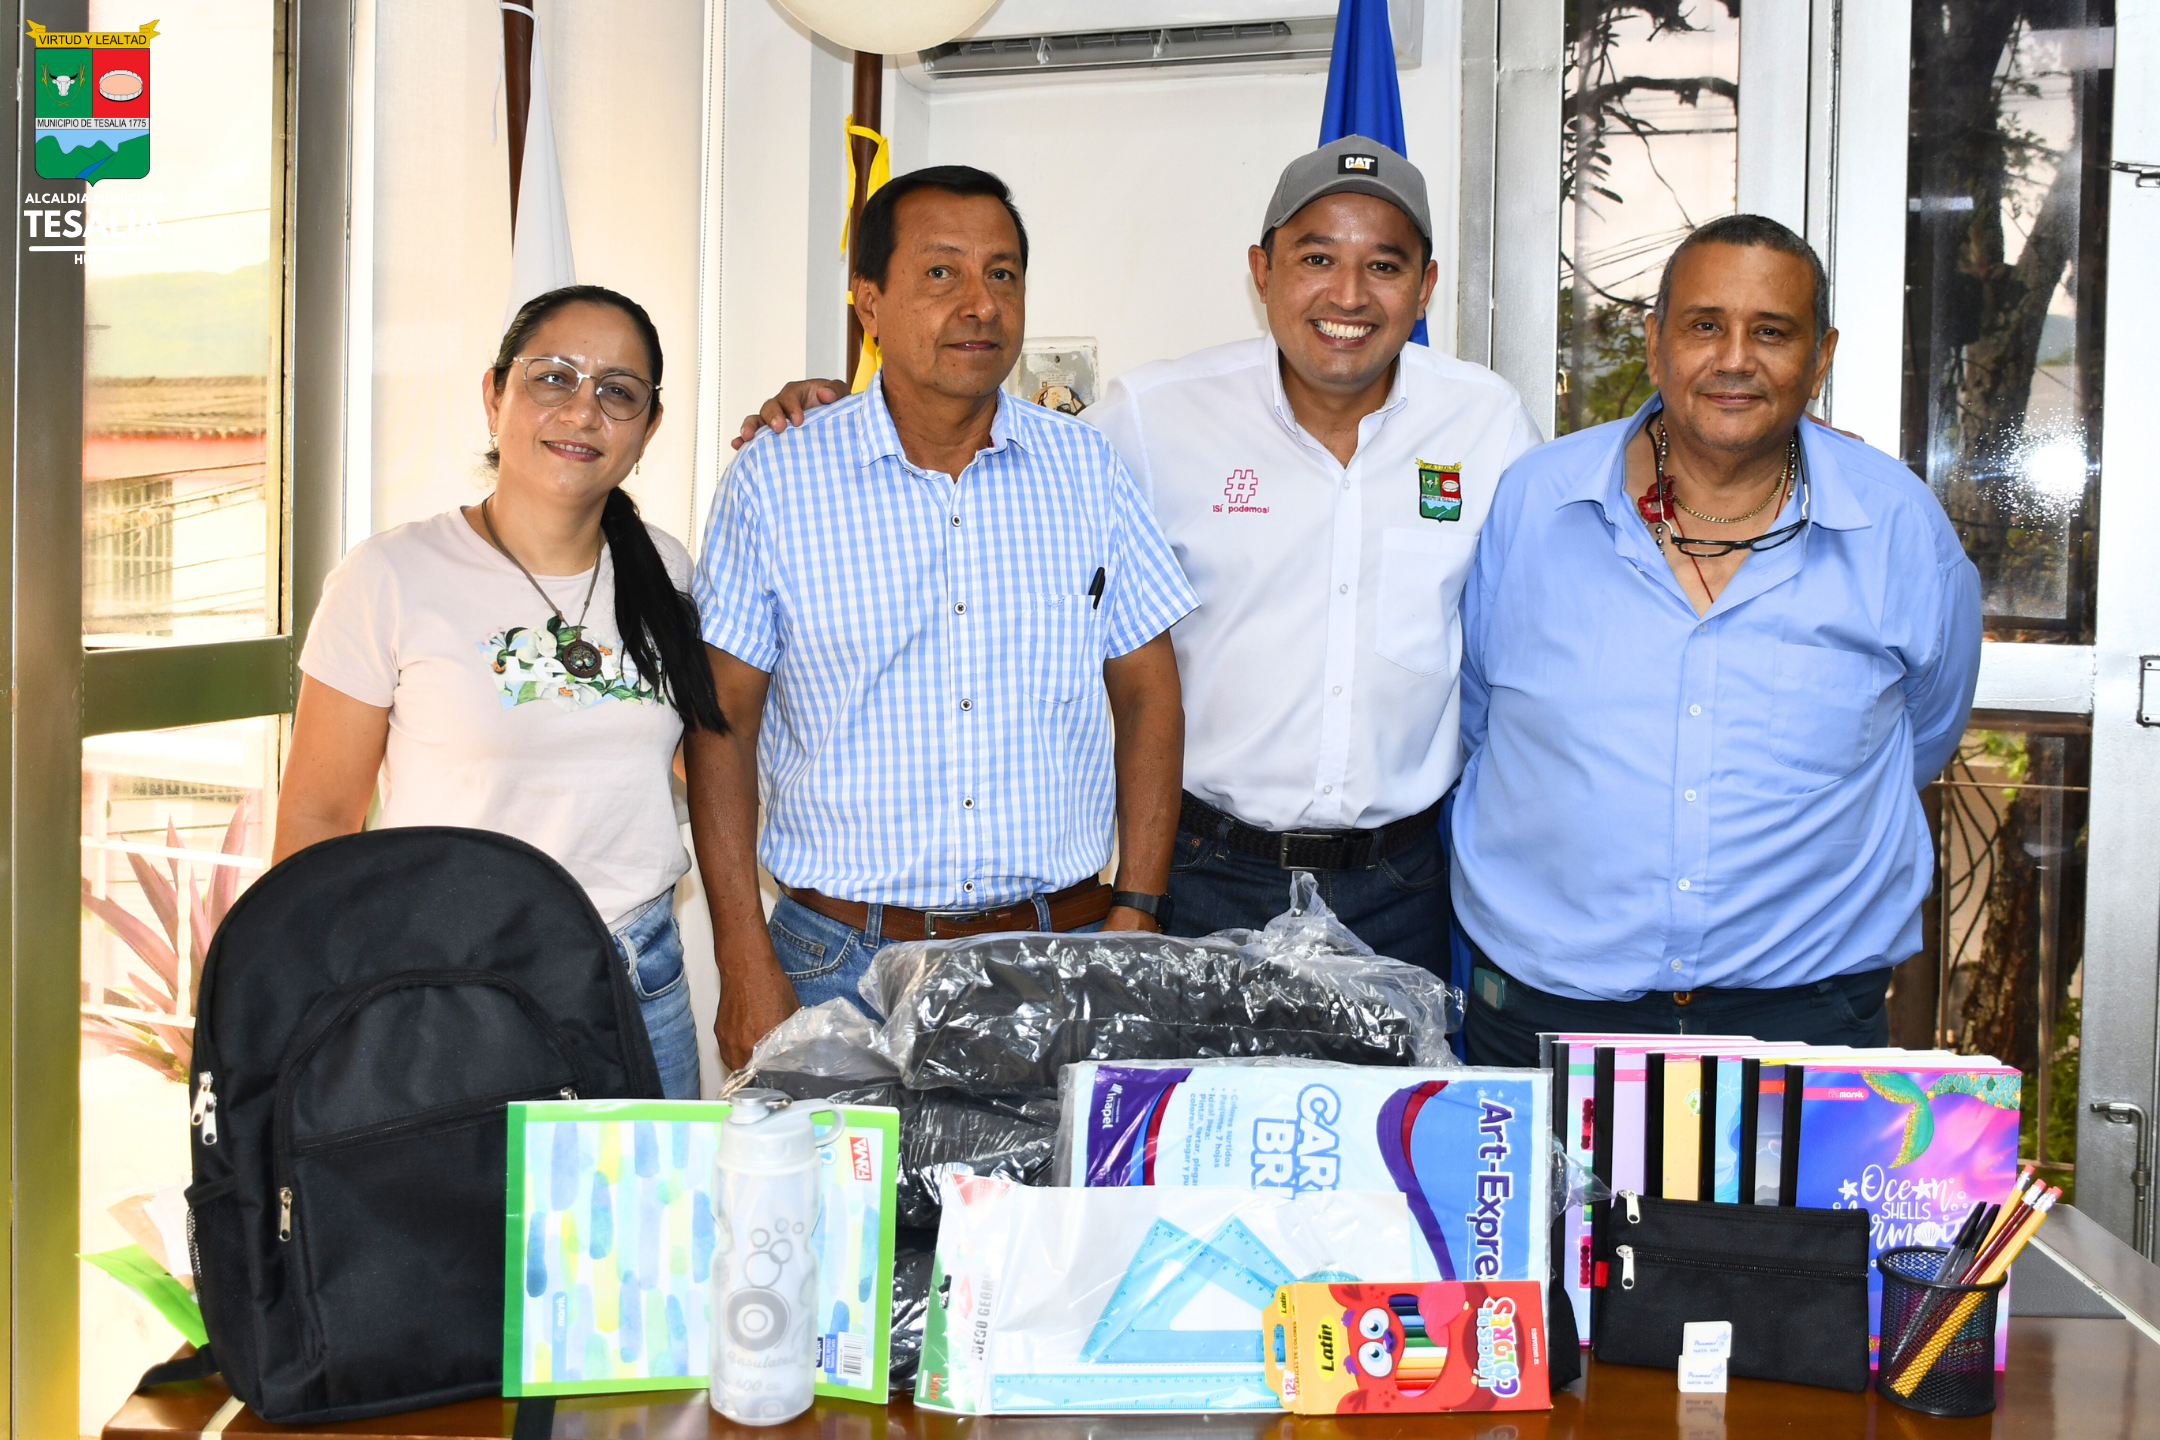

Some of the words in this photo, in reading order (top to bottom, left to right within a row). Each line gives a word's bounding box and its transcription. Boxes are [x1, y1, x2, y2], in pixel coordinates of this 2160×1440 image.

[1345, 157, 1372, 170] CAT
[1207, 1093, 1216, 1116] Ideal
[1839, 1090, 1865, 1098] marfil
[1227, 1094, 1239, 1128] Colores
[1204, 1118, 1214, 1140] para:
[1297, 1083, 1341, 1191] CAR
[852, 1137, 871, 1180] FAMA
[1213, 1143, 1223, 1168] hojas
[1224, 1130, 1233, 1168] surtidos
[1466, 1098, 1514, 1281] Art-Expre
[1881, 1201, 1931, 1220] SHELLS
[1477, 1307, 1494, 1326] DE
[1318, 1324, 1335, 1372] Latin
[1473, 1326, 1496, 1388] LÁPICES
[1490, 1296, 1521, 1398] COLORES
[929, 1392, 939, 1400] 4
